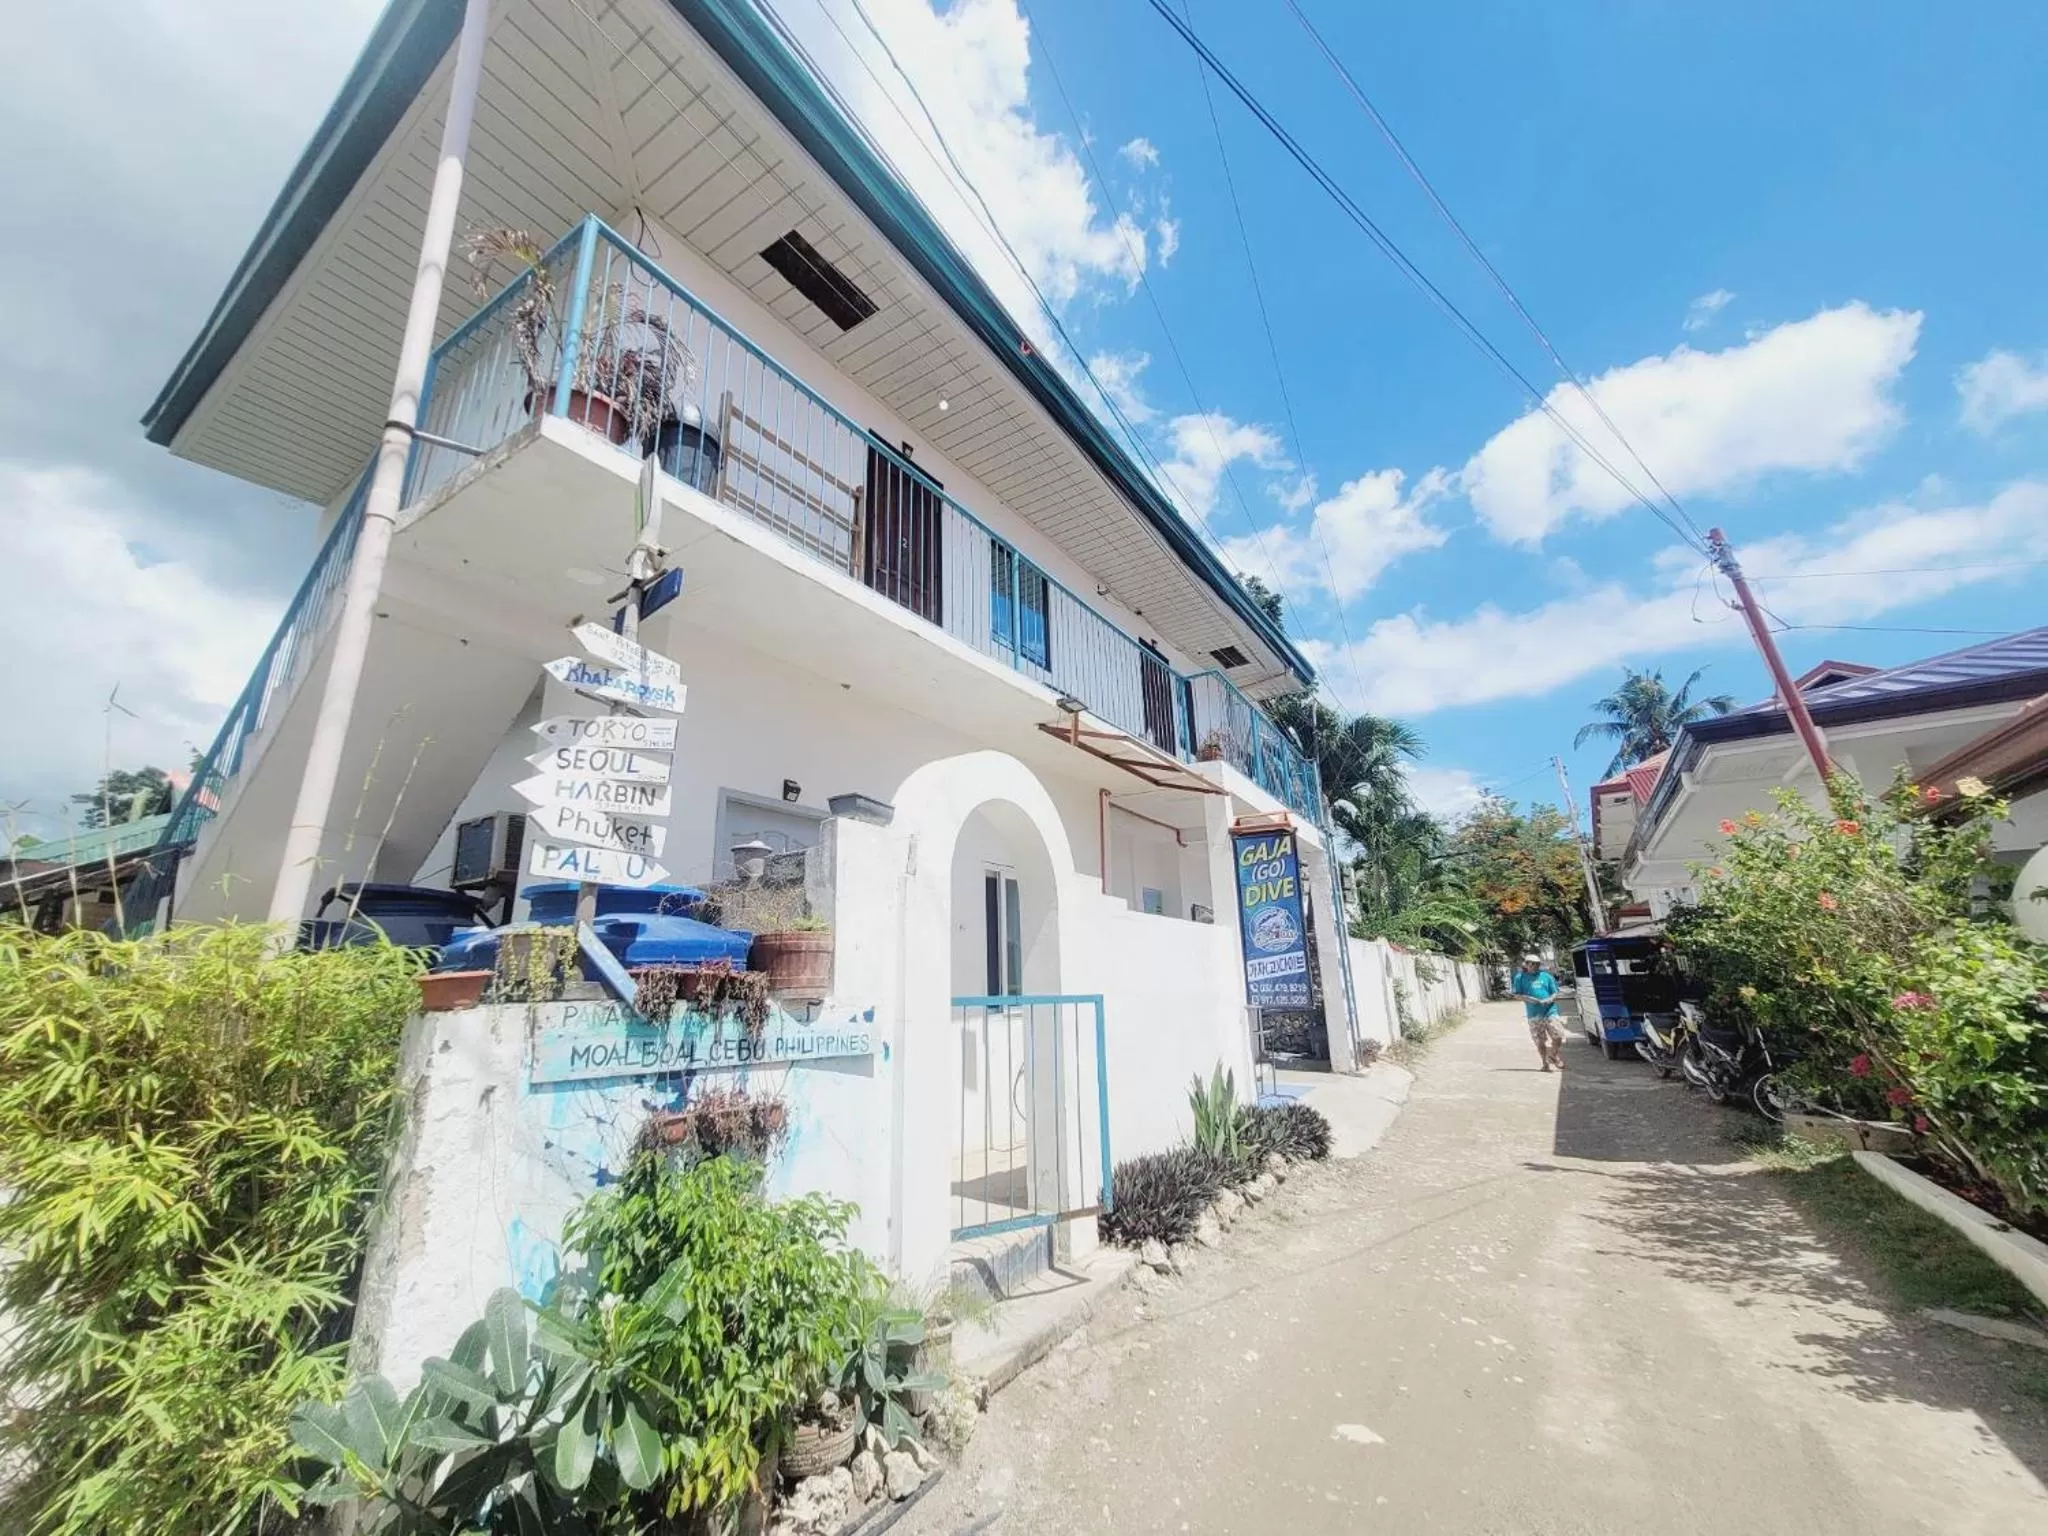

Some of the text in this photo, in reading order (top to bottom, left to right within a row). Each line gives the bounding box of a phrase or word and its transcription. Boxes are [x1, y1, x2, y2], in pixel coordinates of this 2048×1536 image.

[568, 719, 647, 741] TOKYO
[556, 748, 641, 773] SEOUL
[555, 779, 656, 806] HARBIN
[557, 806, 653, 846] Phuket
[1239, 835, 1292, 867] GAJA
[1252, 859, 1286, 883] (GO)
[1245, 876, 1295, 907] DIVE
